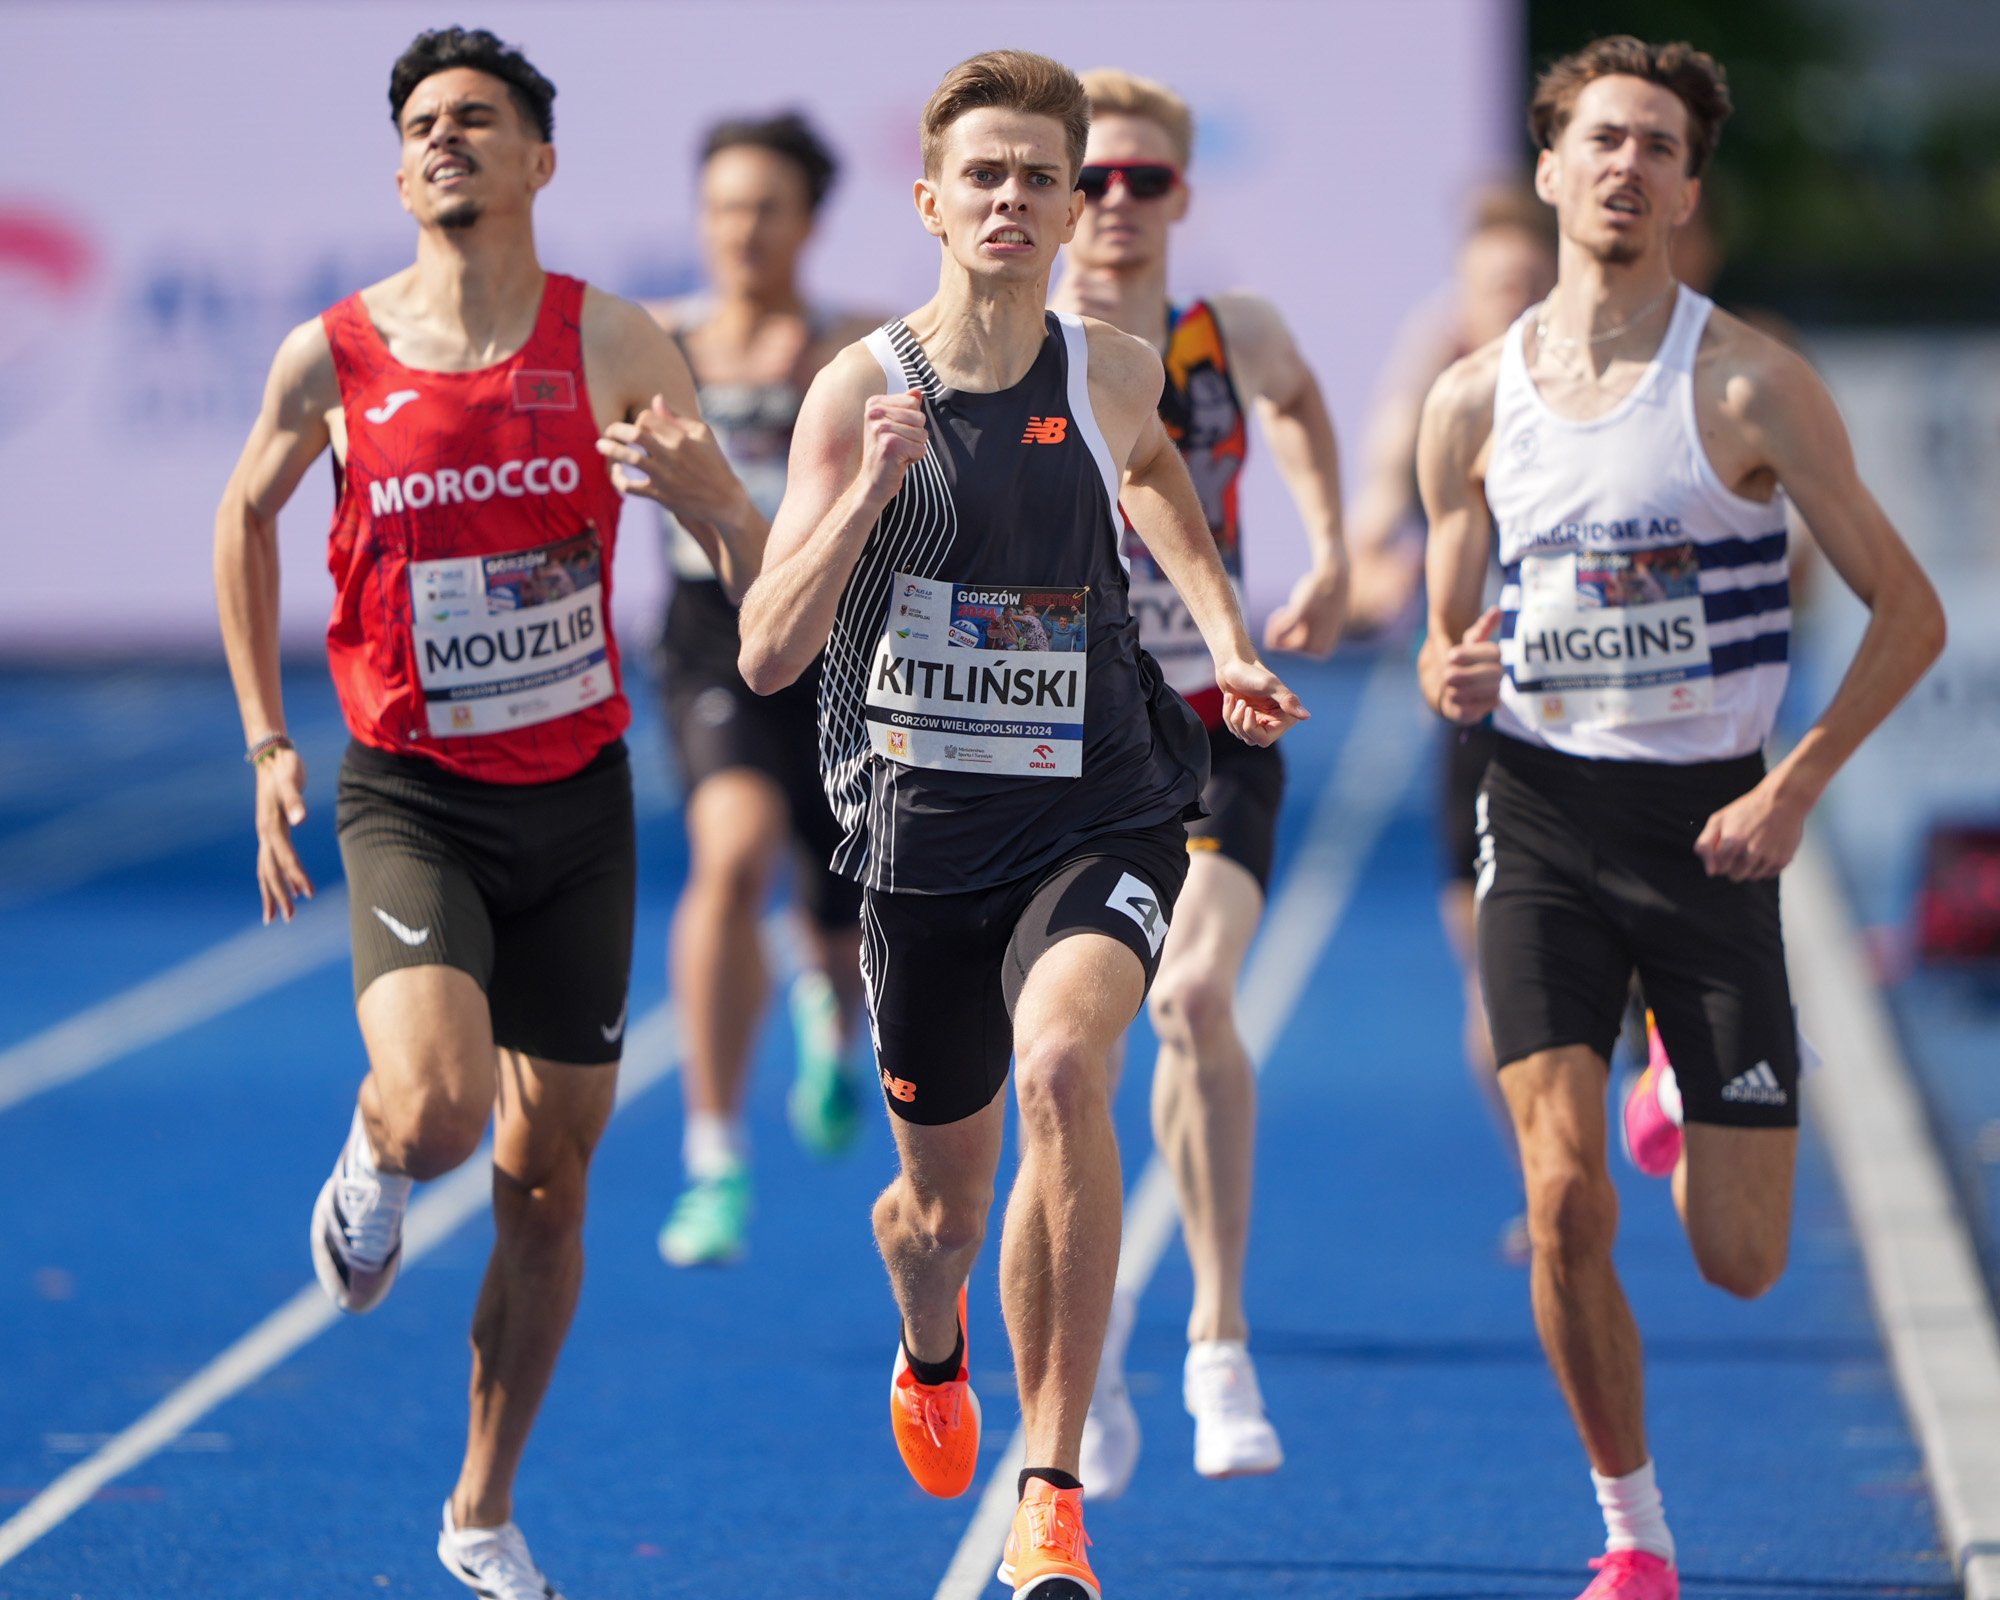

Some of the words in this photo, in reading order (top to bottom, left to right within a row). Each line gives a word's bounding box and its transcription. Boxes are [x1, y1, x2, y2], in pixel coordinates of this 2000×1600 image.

[369, 456, 580, 517] MOROCCO
[1518, 519, 1641, 548] NBRIDGE
[1648, 517, 1682, 537] AC
[957, 590, 1021, 606] GORZÓW
[957, 605, 997, 619] 2024
[425, 604, 595, 674] MOUZLIB
[1523, 616, 1696, 663] HIGGINS
[877, 653, 1078, 708] KITLIŃSKI
[890, 713, 940, 729] GORZÓW
[941, 720, 1023, 735] WIELKOPOLSKI
[1025, 725, 1053, 736] 2024
[1029, 761, 1056, 770] ORLEN
[1125, 896, 1159, 937] 4
[1721, 1085, 1788, 1106] adidas
